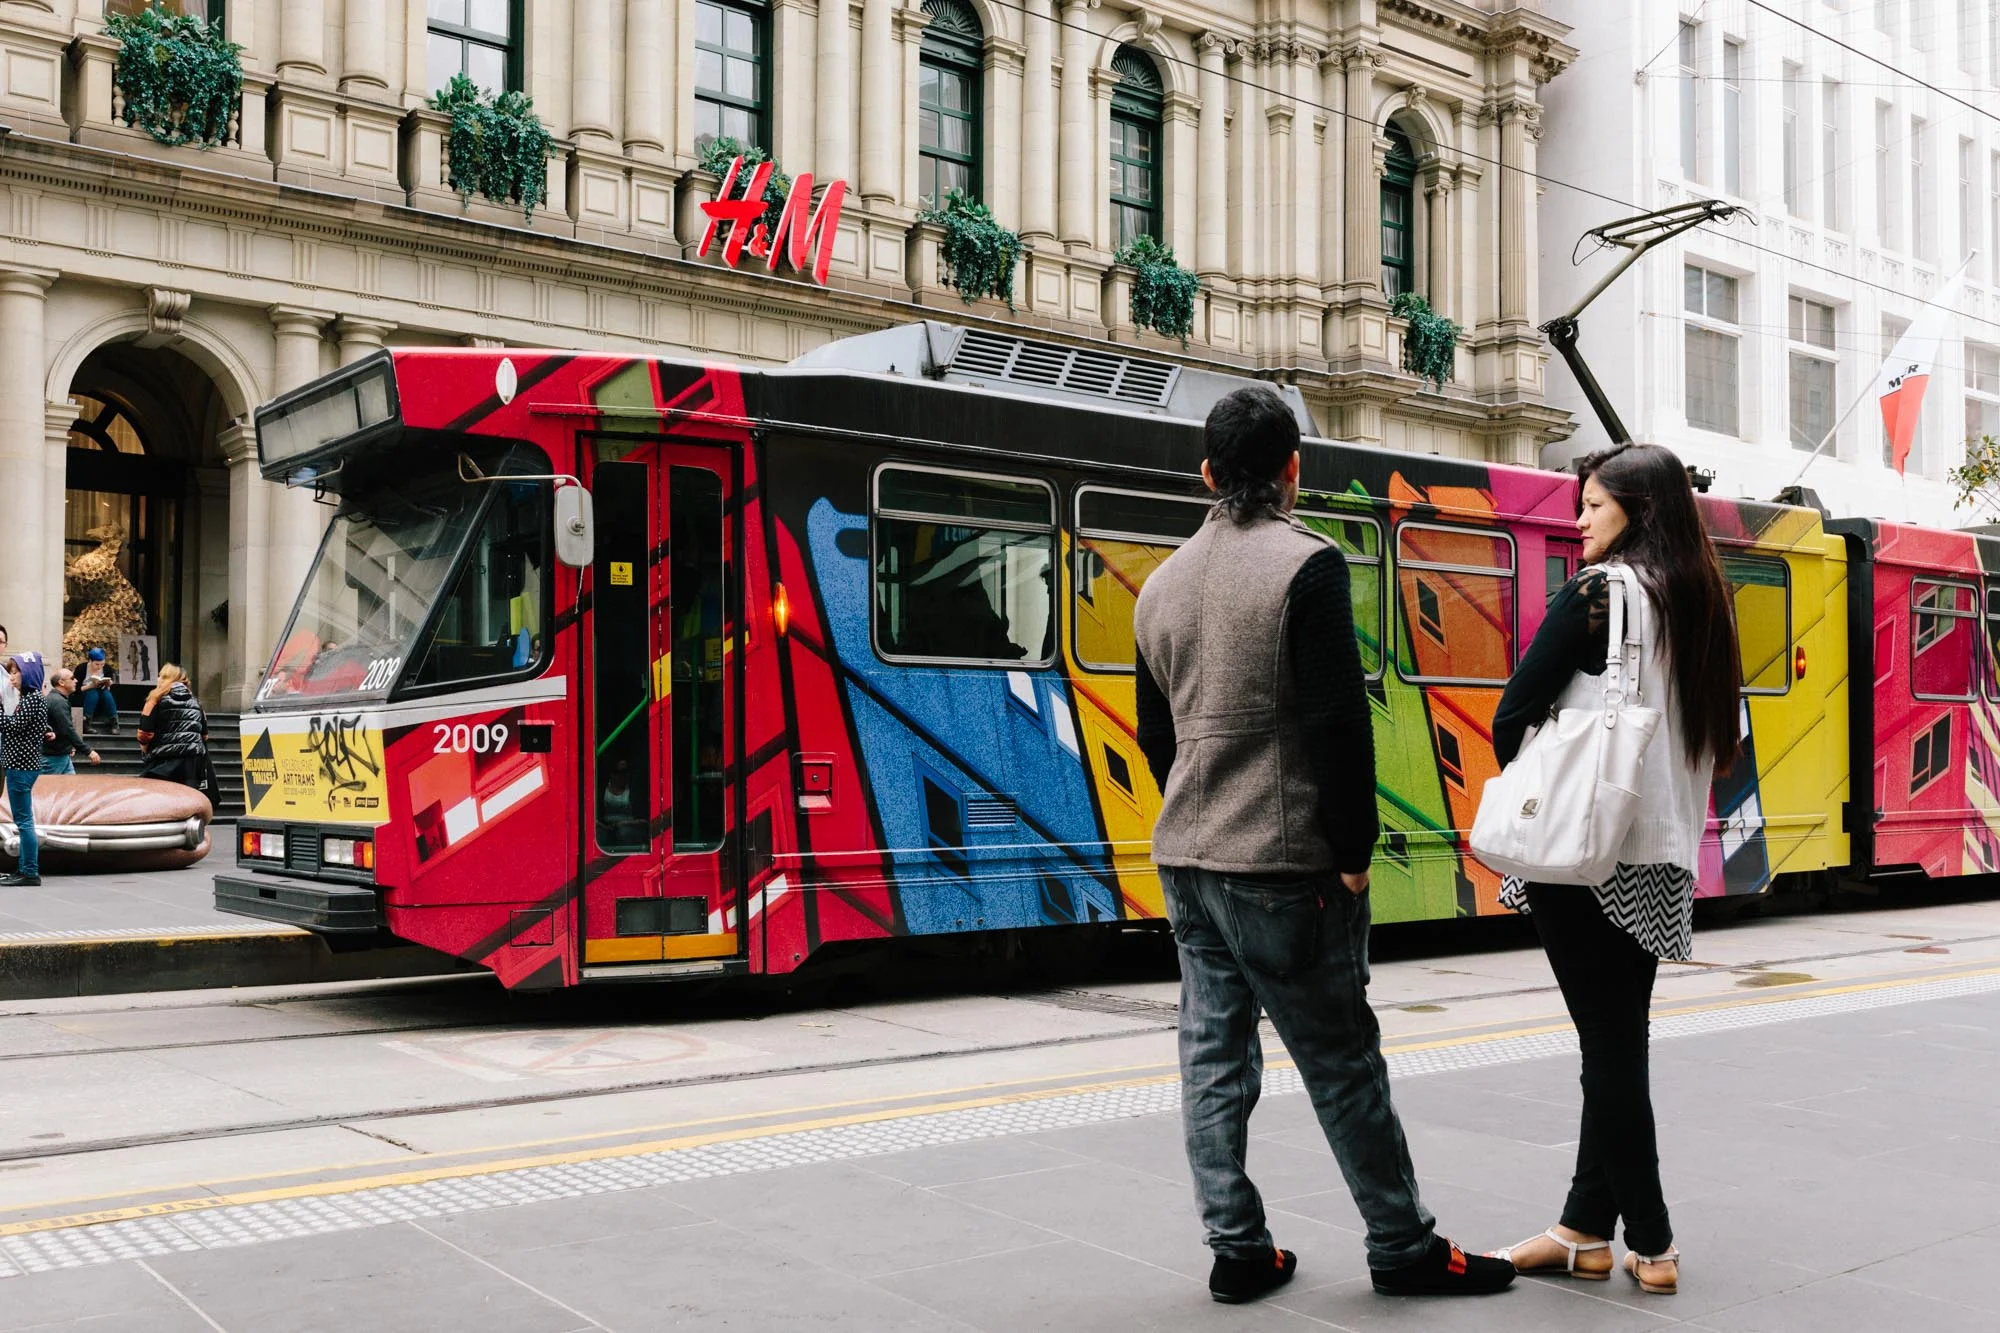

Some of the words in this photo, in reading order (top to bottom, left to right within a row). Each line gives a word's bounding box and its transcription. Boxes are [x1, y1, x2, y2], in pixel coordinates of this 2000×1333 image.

[697, 155, 847, 286] H&M
[358, 657, 401, 691] 2009
[432, 723, 509, 754] 2009
[283, 774, 293, 785] ART
[294, 774, 315, 786] TRAMS
